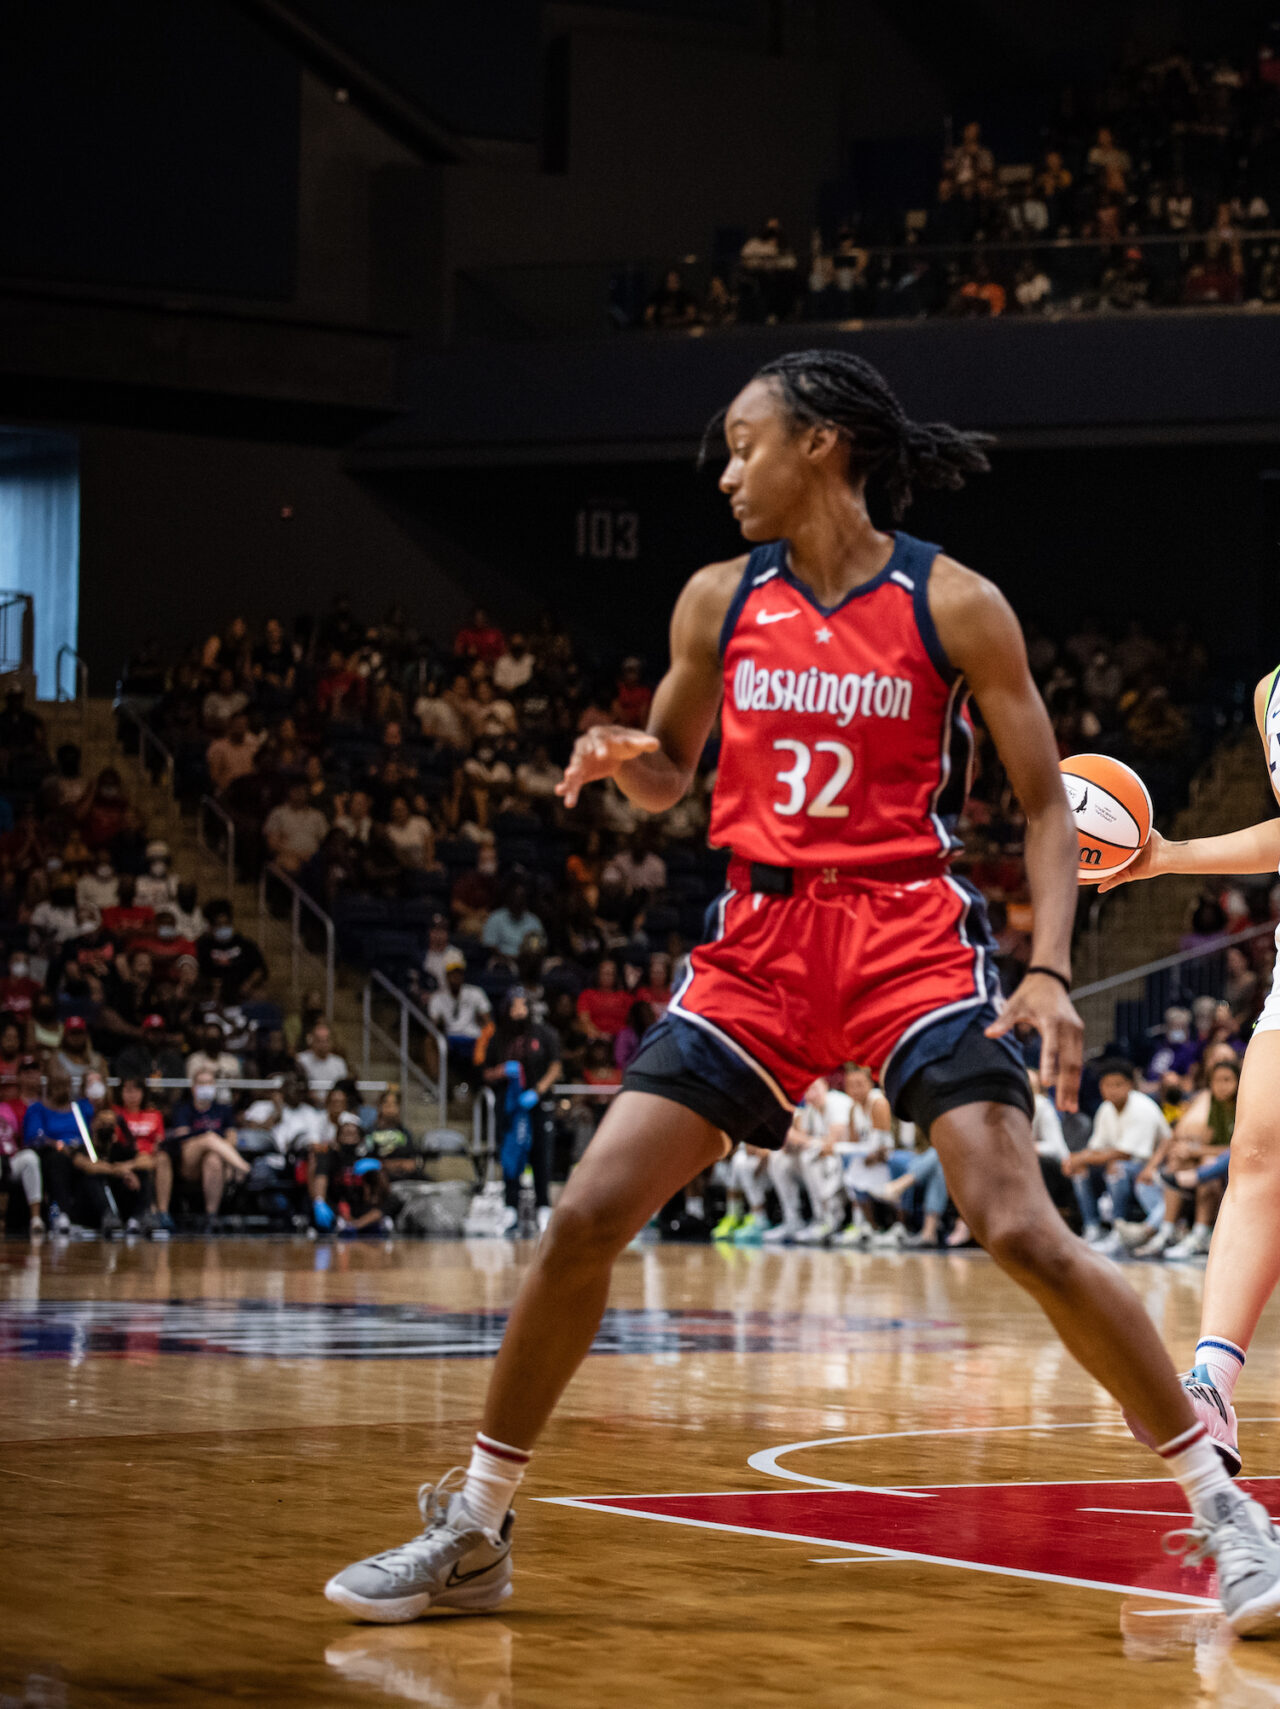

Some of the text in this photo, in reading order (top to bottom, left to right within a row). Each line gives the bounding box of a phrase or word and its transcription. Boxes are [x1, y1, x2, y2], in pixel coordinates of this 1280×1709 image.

[576, 509, 640, 560] 103
[733, 658, 913, 727] Washington
[773, 739, 854, 818] 32
